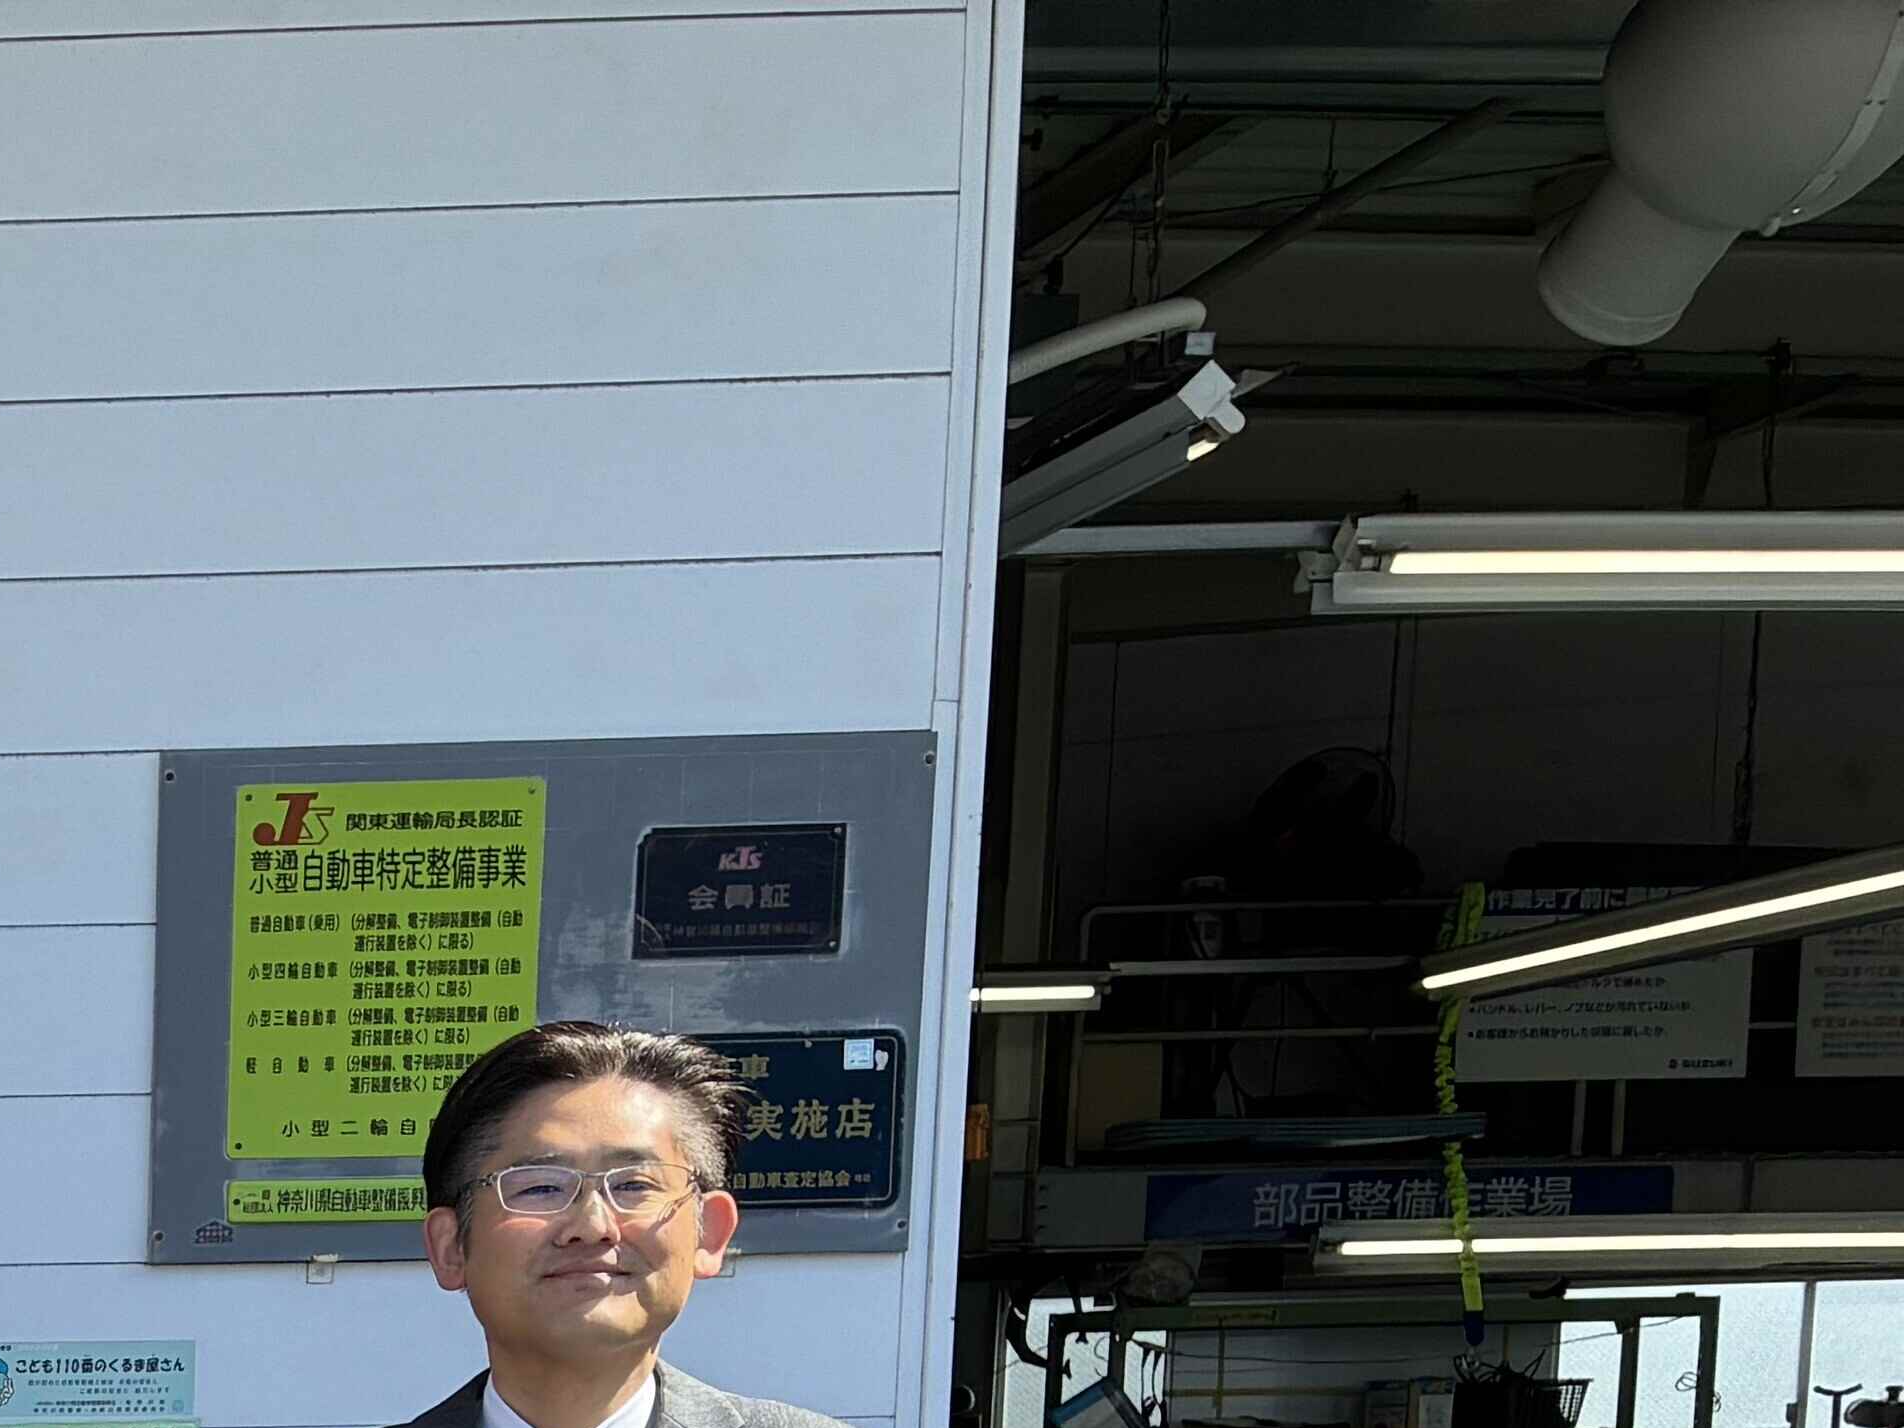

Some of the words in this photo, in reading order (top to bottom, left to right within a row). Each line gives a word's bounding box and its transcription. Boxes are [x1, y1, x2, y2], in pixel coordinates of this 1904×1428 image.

[345, 809, 524, 832] 関東運輸局長認証
[250, 851, 298, 873] 普通
[303, 845, 528, 892] 自動車特定整備事業
[249, 874, 298, 894] 小型
[282, 1120, 437, 1137] 小型二輪自
[745, 1098, 875, 1140] 実施店
[1254, 1176, 1572, 1227] 部品整備作業場
